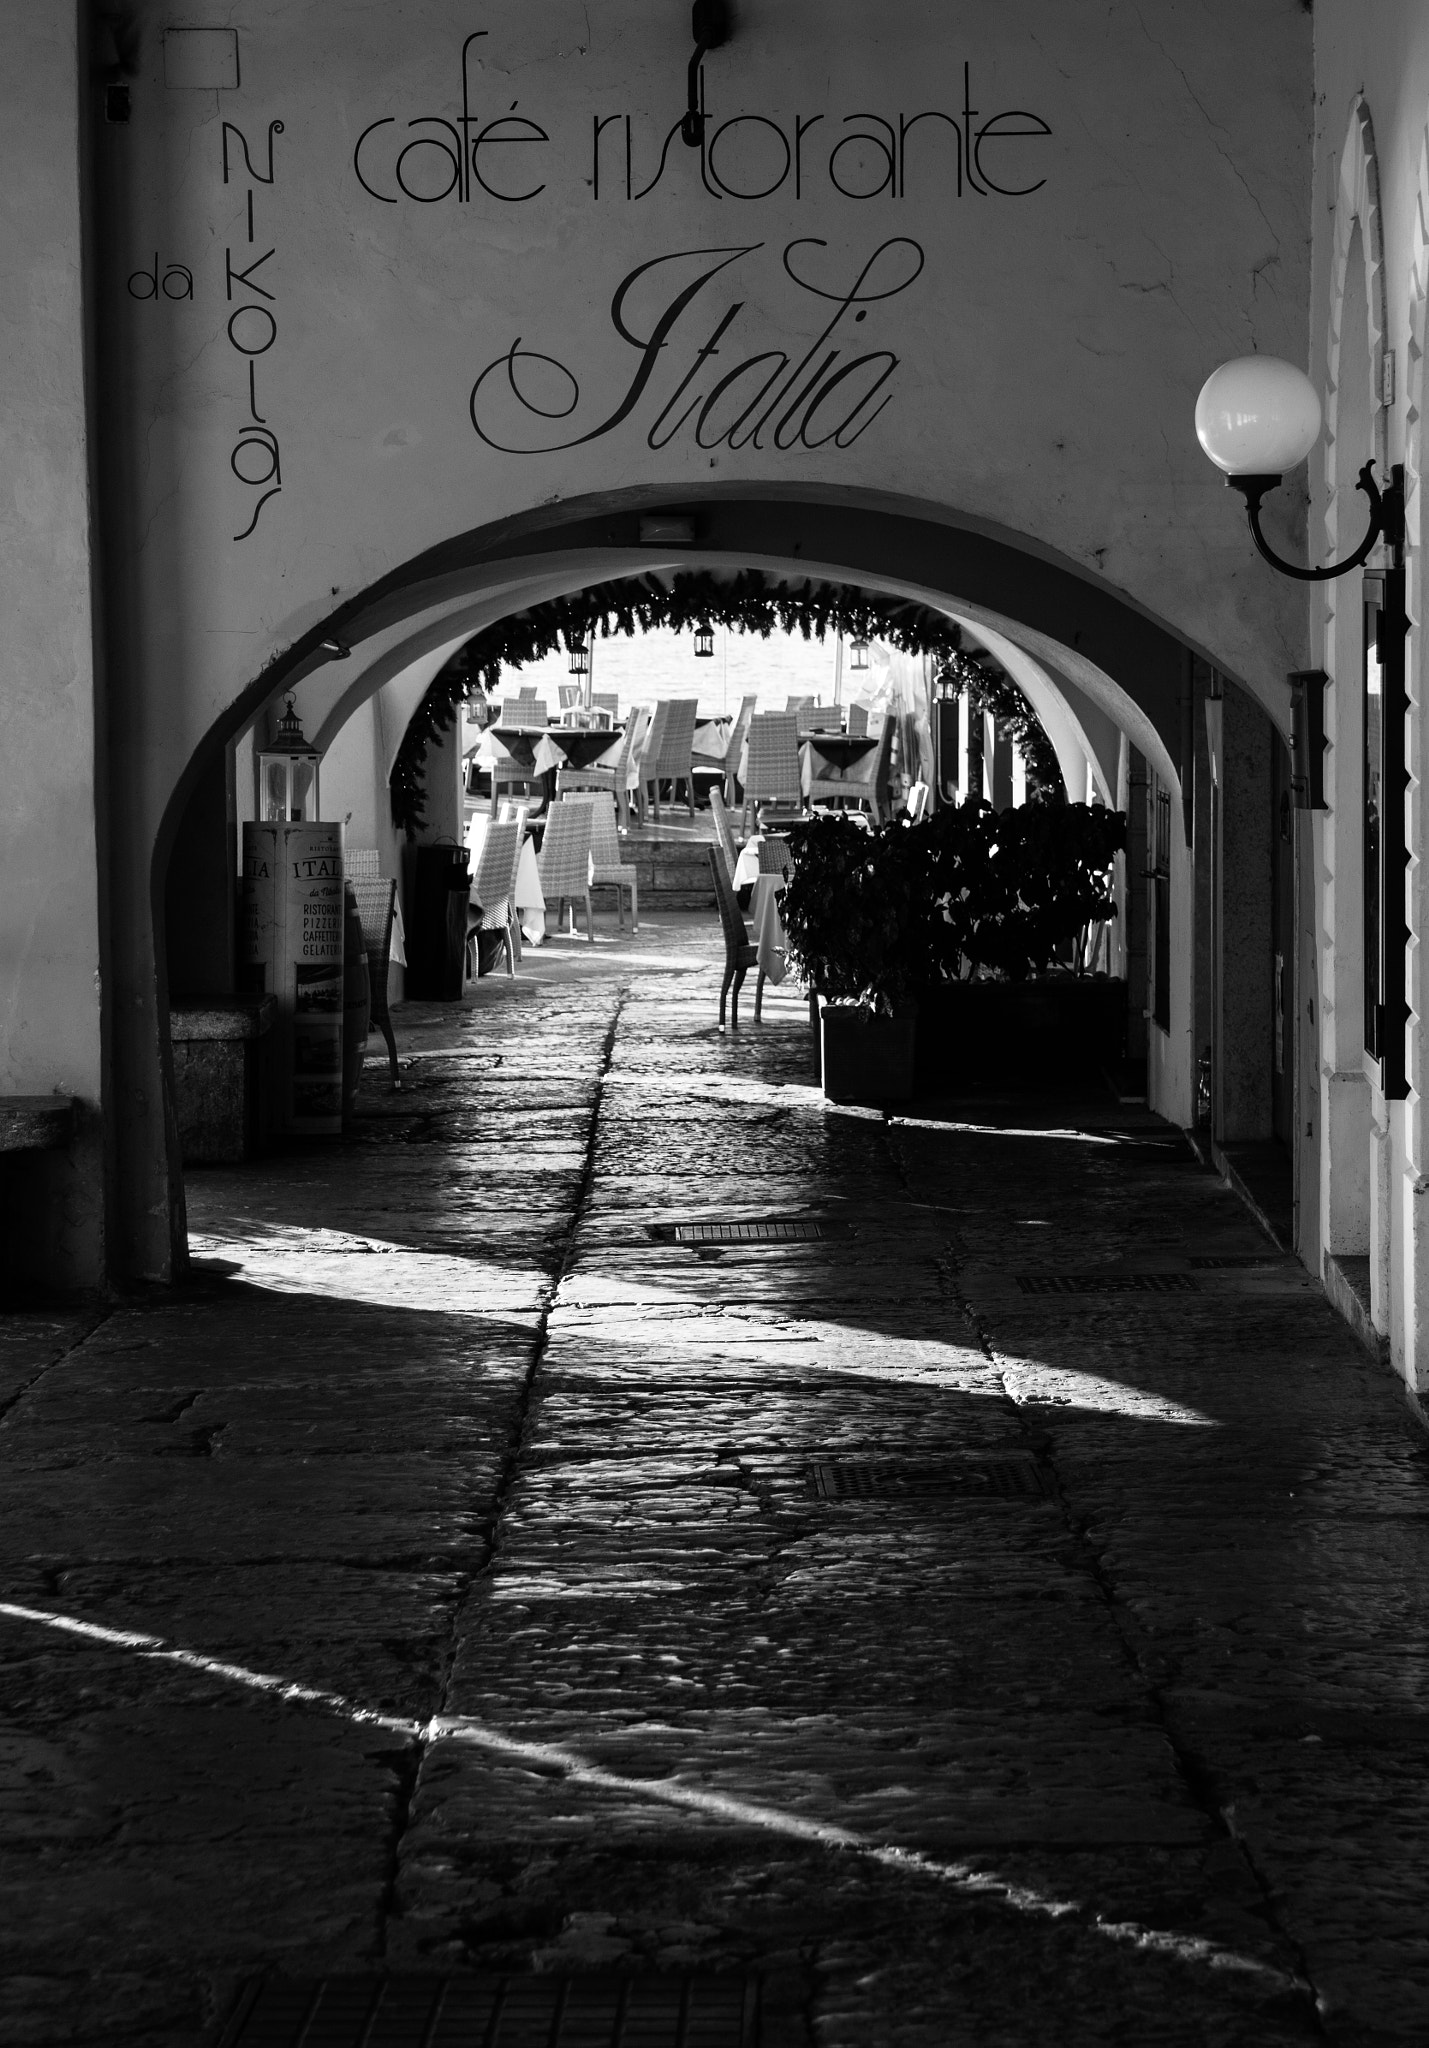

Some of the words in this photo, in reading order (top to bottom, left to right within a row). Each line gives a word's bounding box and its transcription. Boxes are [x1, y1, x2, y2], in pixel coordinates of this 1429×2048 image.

[354, 31, 551, 204] café
[594, 61, 1054, 201] ristorante
[127, 251, 194, 301] da
[470, 237, 926, 455] Italia
